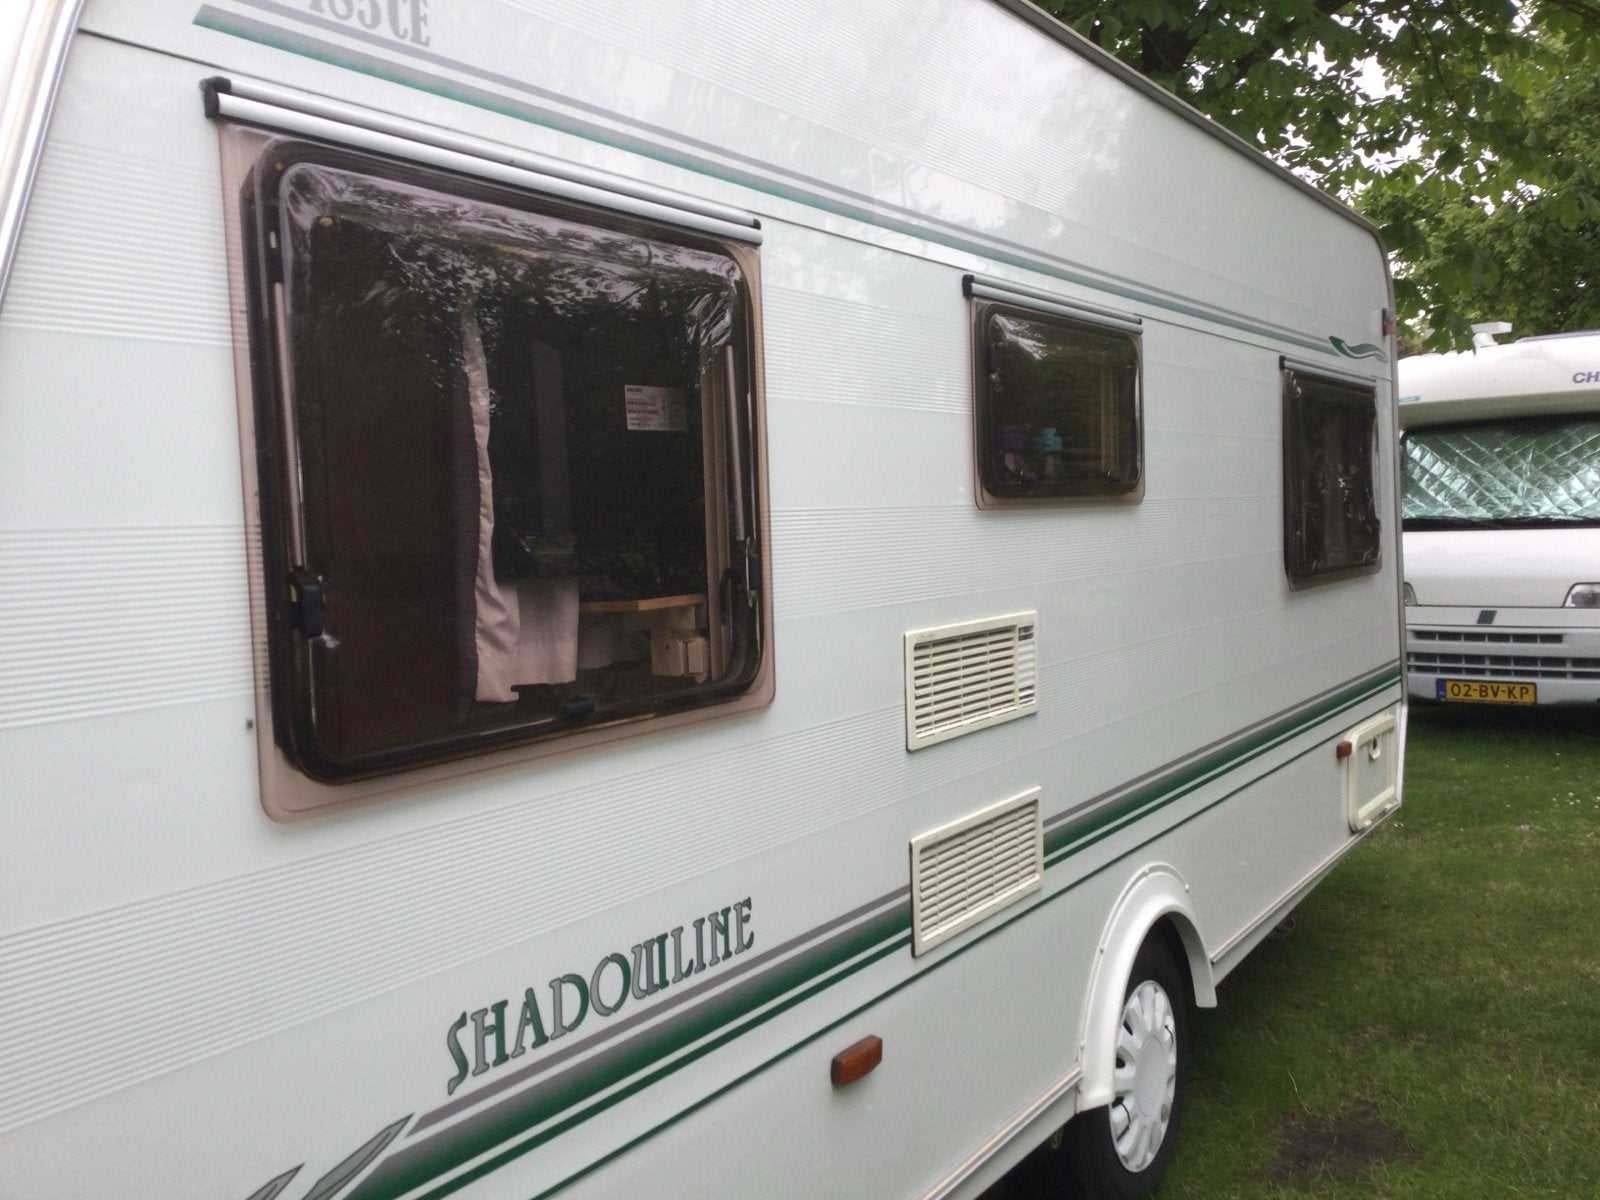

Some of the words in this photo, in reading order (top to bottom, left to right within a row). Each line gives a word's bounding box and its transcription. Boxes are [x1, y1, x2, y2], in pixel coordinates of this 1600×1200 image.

[309, 0, 430, 47] 5CE
[1450, 683, 1530, 700] 02-BV-KP
[446, 896, 755, 1096] SHADOWLINE
